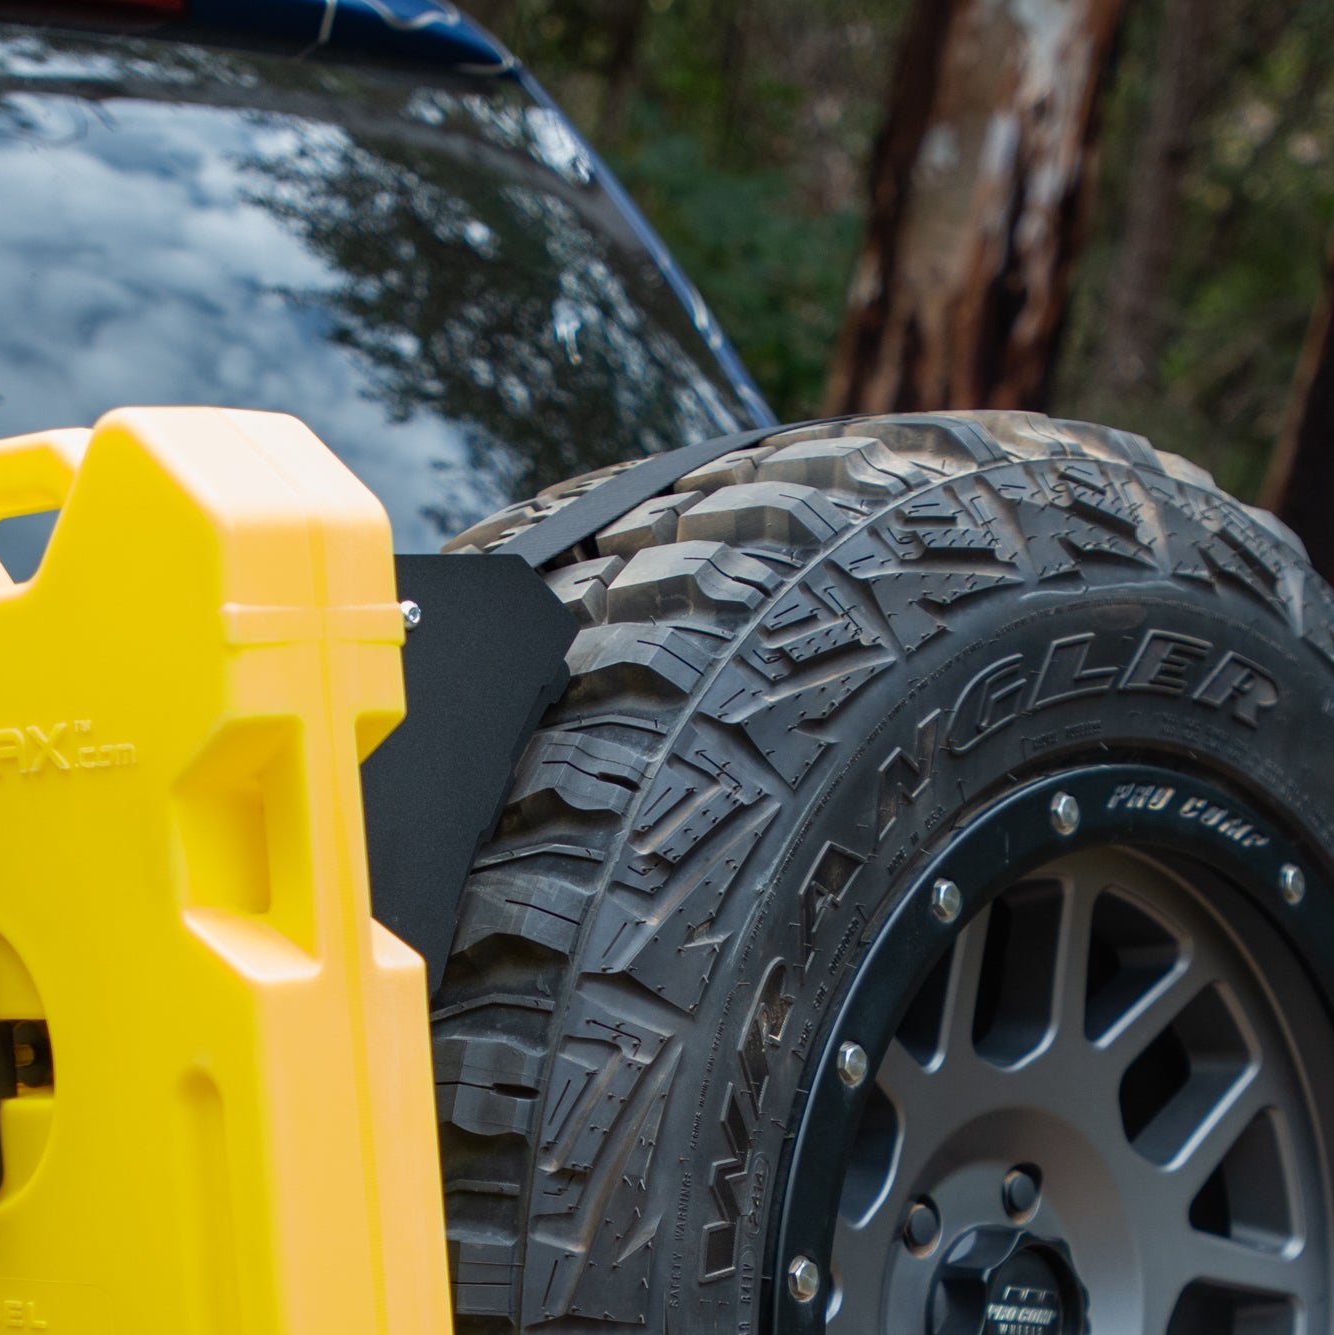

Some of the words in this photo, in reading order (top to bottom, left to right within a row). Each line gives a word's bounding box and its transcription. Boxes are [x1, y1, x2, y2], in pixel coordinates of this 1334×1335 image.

[1106, 782, 1177, 813] PRO
[1177, 796, 1270, 849] COMP
[698, 627, 1282, 1285] WRANGLER
[667, 1250, 683, 1310] SAFETY
[987, 1303, 1017, 1322] PRO
[1017, 1305, 1057, 1326] COMP
